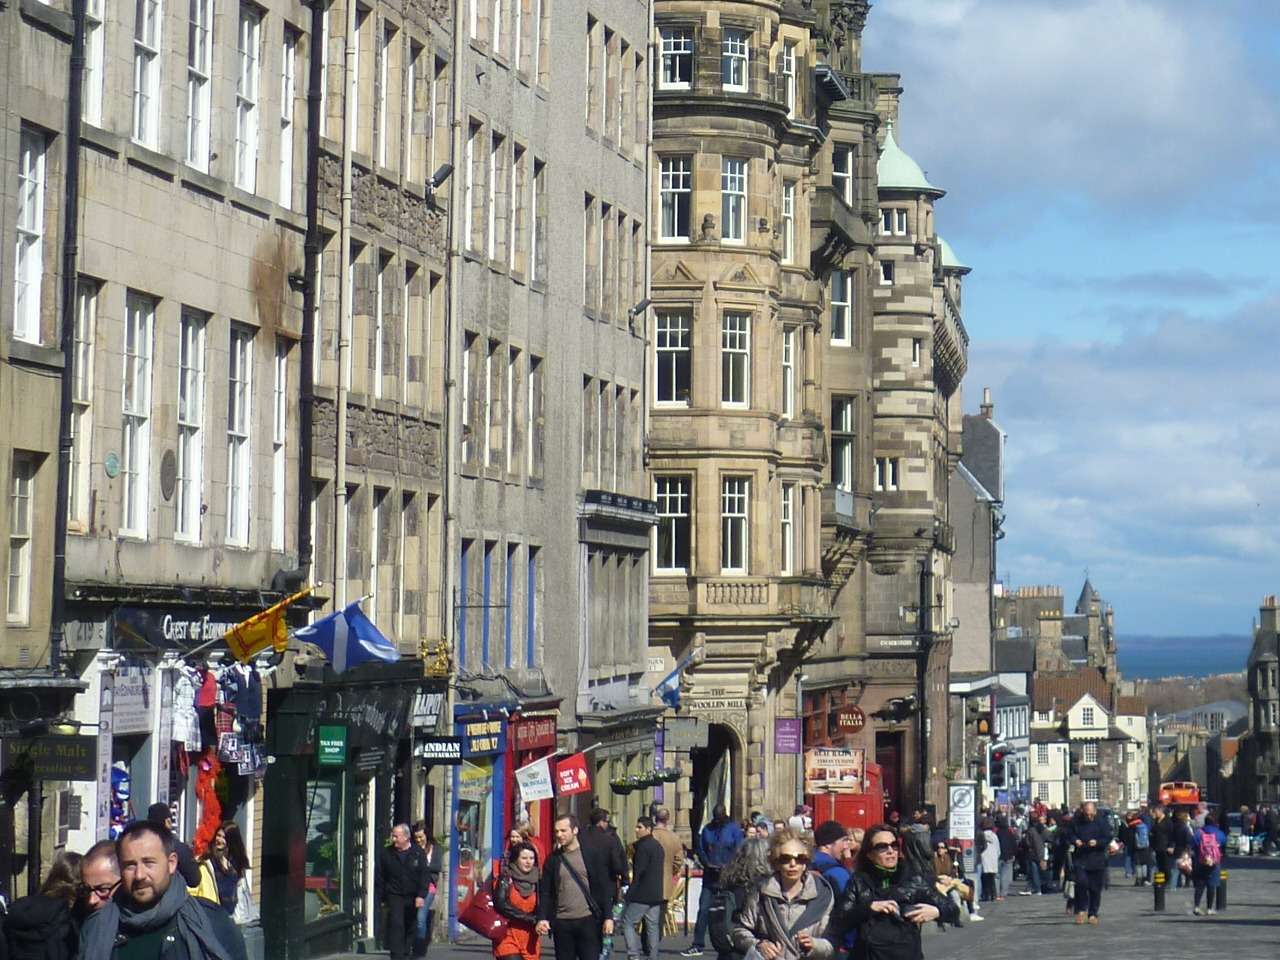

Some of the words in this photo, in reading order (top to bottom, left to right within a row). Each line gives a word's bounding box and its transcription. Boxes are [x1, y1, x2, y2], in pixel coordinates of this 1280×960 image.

[190, 622, 201, 640] OF
[728, 699, 746, 708] MILL
[424, 742, 461, 752] INDIAN
[560, 768, 574, 778] SOFT
[560, 782, 580, 793] CREAM
